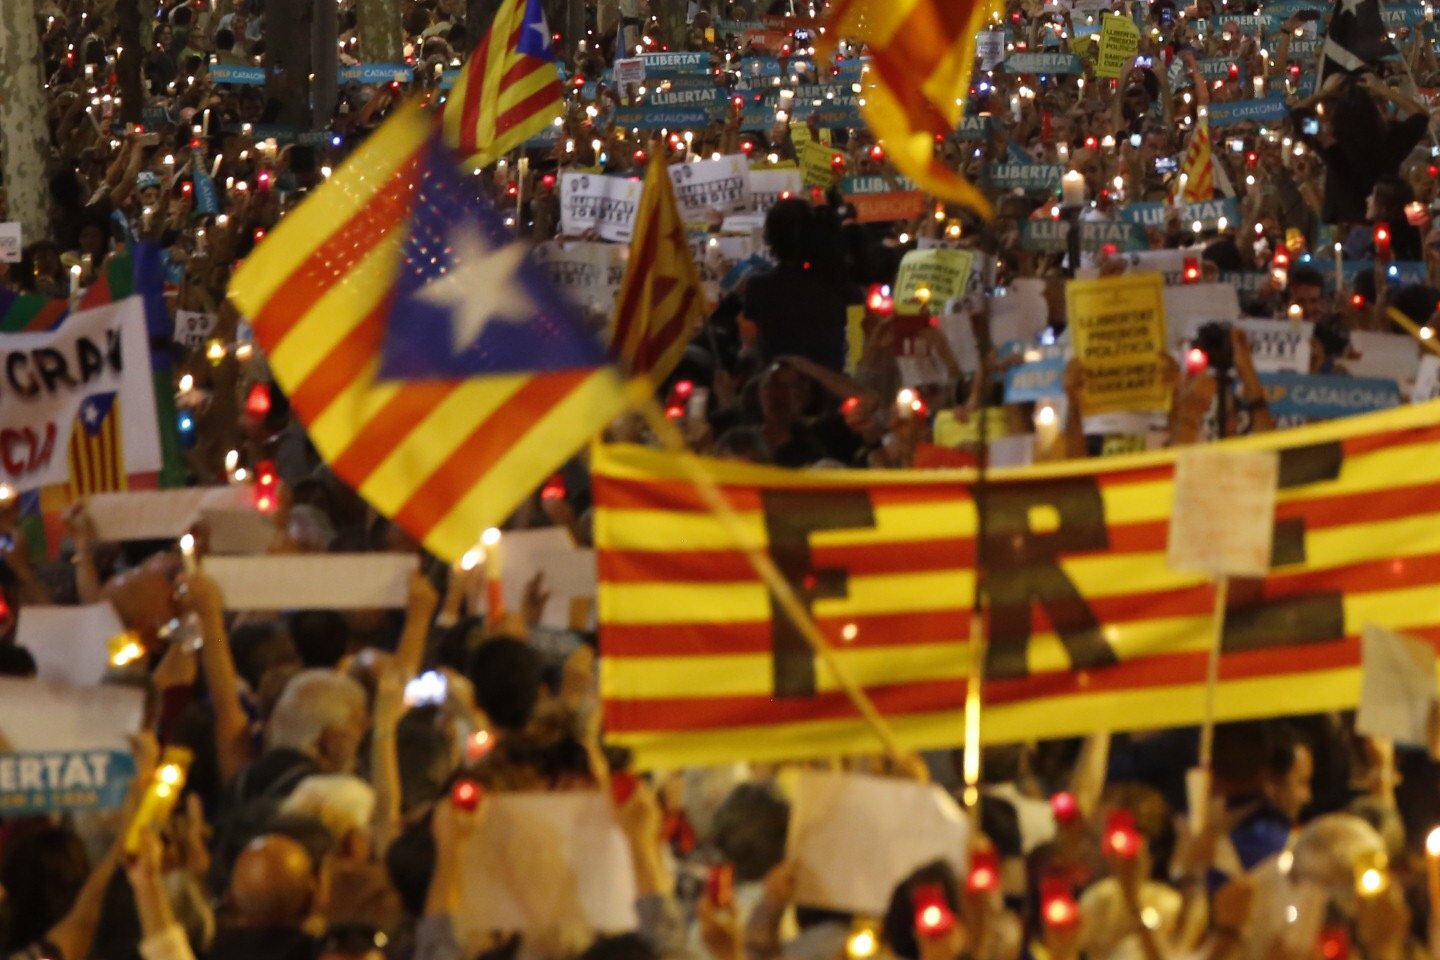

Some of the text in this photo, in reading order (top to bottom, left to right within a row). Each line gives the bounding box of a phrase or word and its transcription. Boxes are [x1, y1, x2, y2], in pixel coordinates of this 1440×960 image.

[645, 54, 700, 67] LLIBERTAT
[652, 88, 717, 105] LLIBERTAT
[617, 113, 704, 123] HELP CATALONIA
[1233, 102, 1286, 118] CATALONIA
[1012, 369, 1058, 389] HELP
[1291, 384, 1399, 407] CATALONIA
